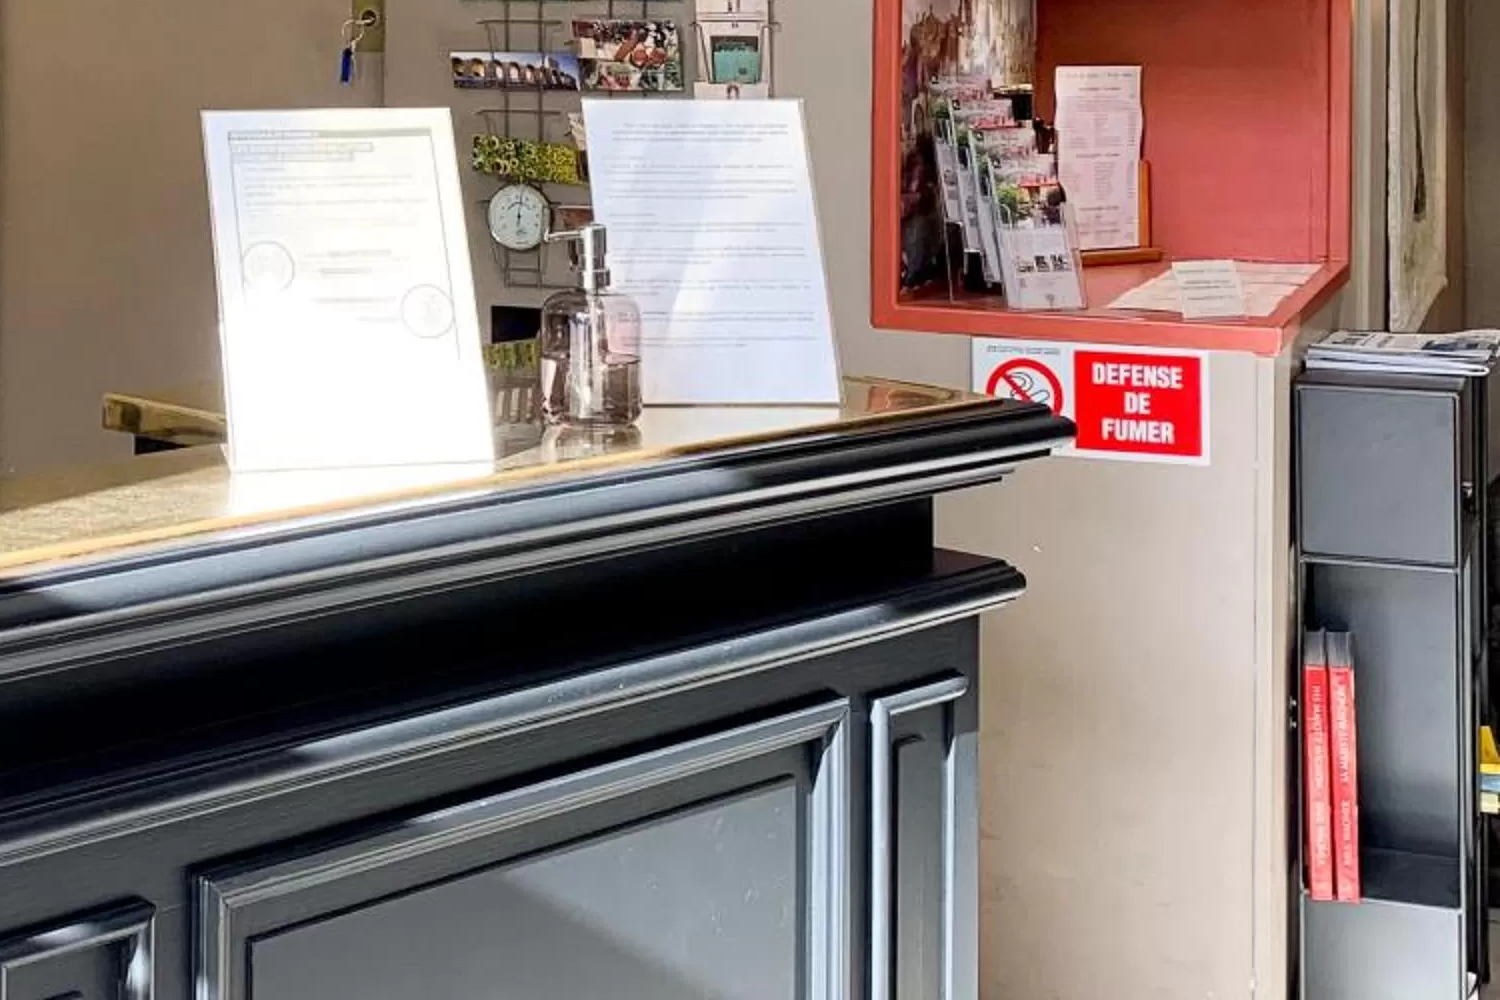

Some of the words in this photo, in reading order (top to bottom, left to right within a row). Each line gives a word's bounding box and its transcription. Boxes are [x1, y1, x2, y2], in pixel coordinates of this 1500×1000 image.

[1091, 362, 1184, 389] DEFENSE
[1124, 391, 1151, 415] DE
[1101, 417, 1175, 445] FUMER
